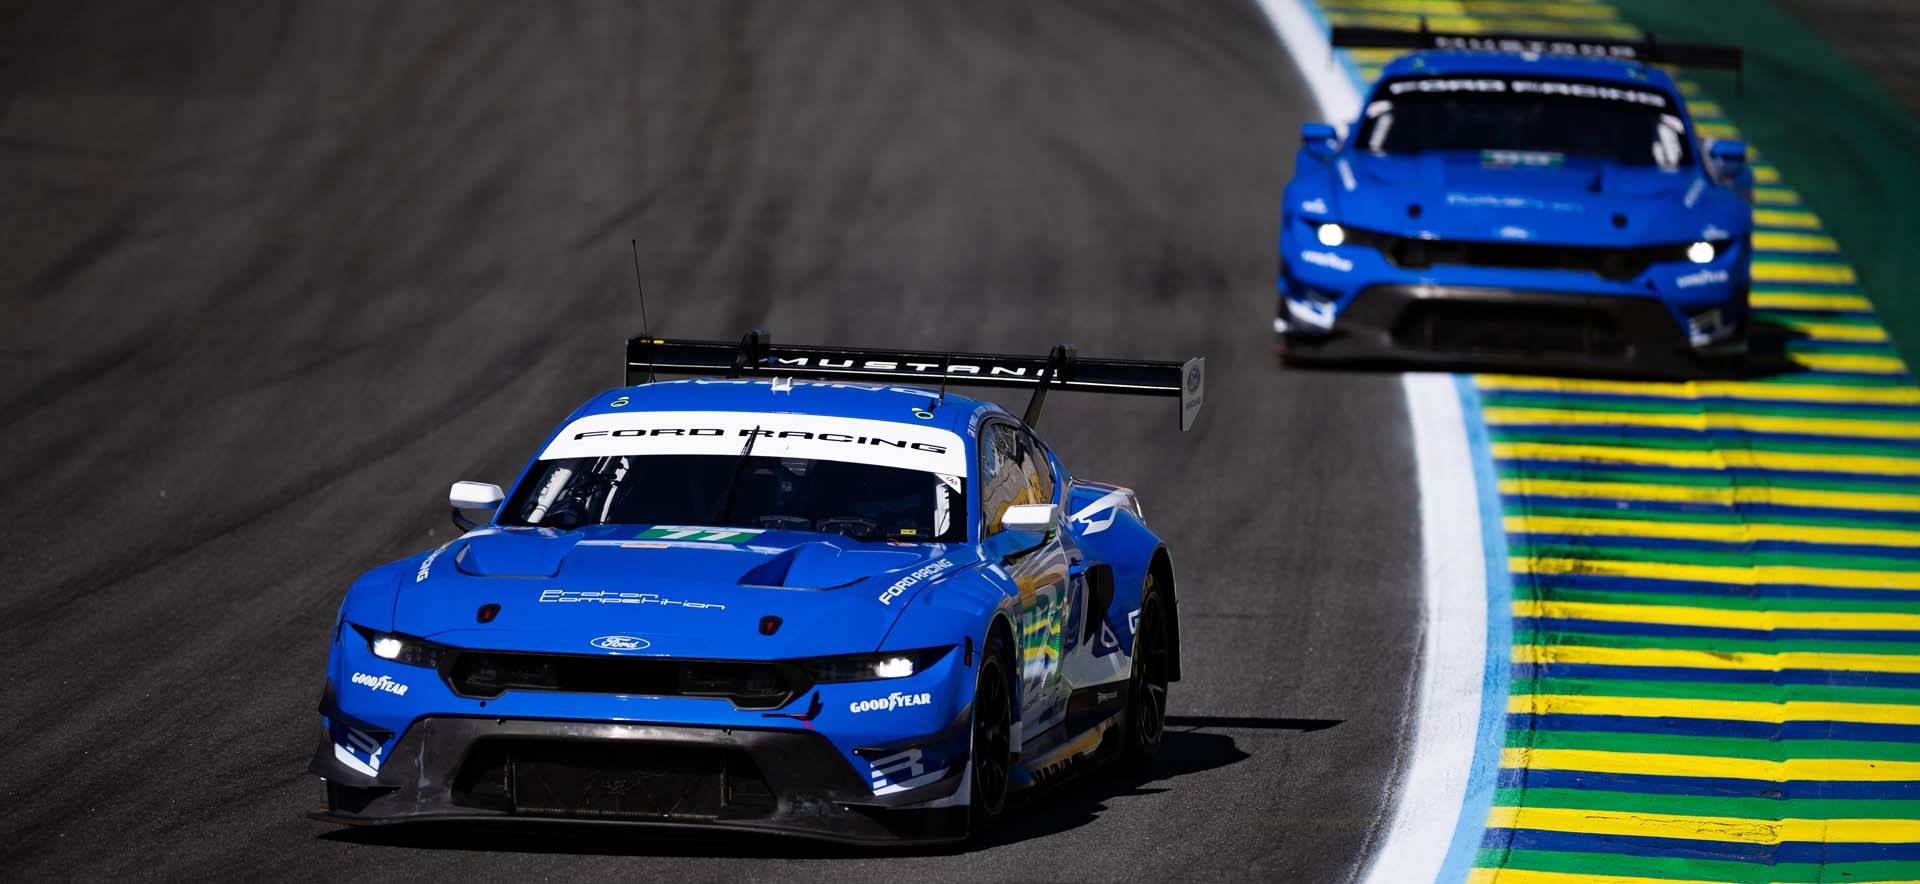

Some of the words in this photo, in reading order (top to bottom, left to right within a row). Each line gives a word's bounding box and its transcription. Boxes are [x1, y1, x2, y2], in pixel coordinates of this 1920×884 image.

[574, 428, 724, 440] FORD
[738, 428, 947, 454] RACING
[660, 528, 741, 542] 77
[879, 576, 918, 605] FORD
[911, 558, 954, 580] RACING
[539, 595, 726, 611] Competition
[541, 589, 659, 600] Proton
[600, 636, 640, 649] Ford
[351, 672, 408, 696] GOODYEAR
[849, 692, 931, 713] GOODYEAR
